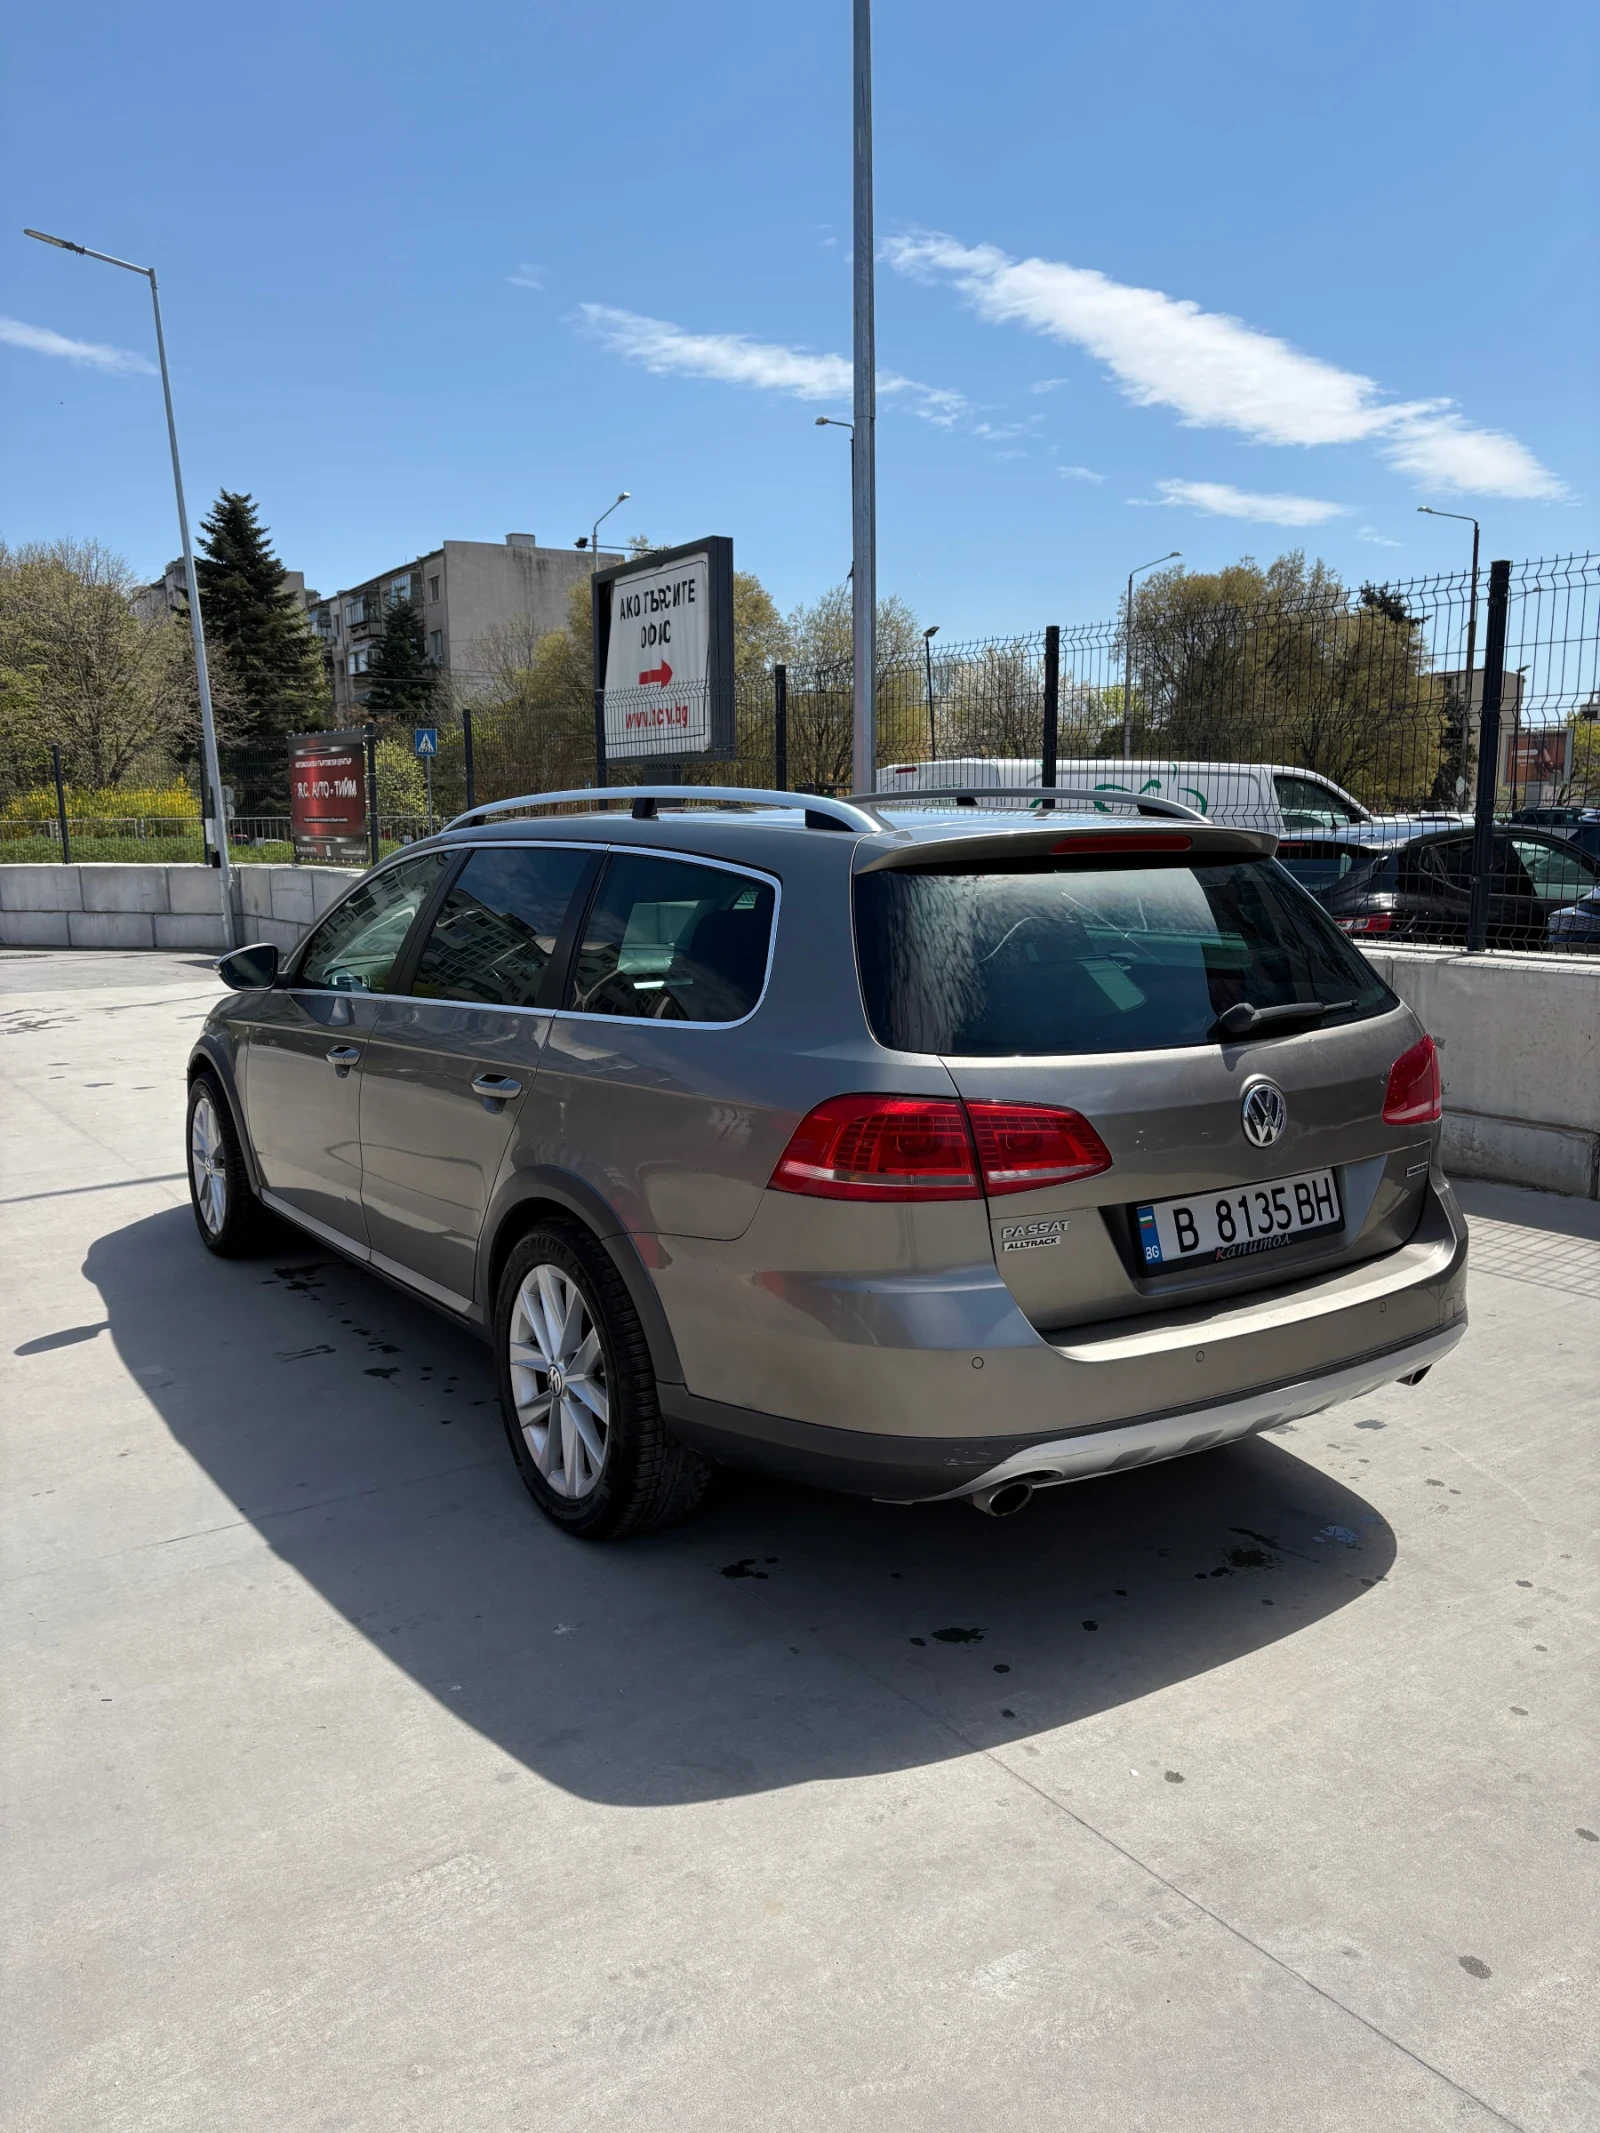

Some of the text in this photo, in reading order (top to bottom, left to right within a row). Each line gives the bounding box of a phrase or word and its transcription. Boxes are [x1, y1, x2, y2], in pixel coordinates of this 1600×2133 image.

[620, 579, 695, 620] АКО ТЪРСИТЕ
[1172, 1177, 1335, 1253] B 8135 BH
[1001, 1220, 1071, 1239] PASSAT
[1007, 1237, 1058, 1250] ALLTRACK
[1145, 1246, 1160, 1260] BG
